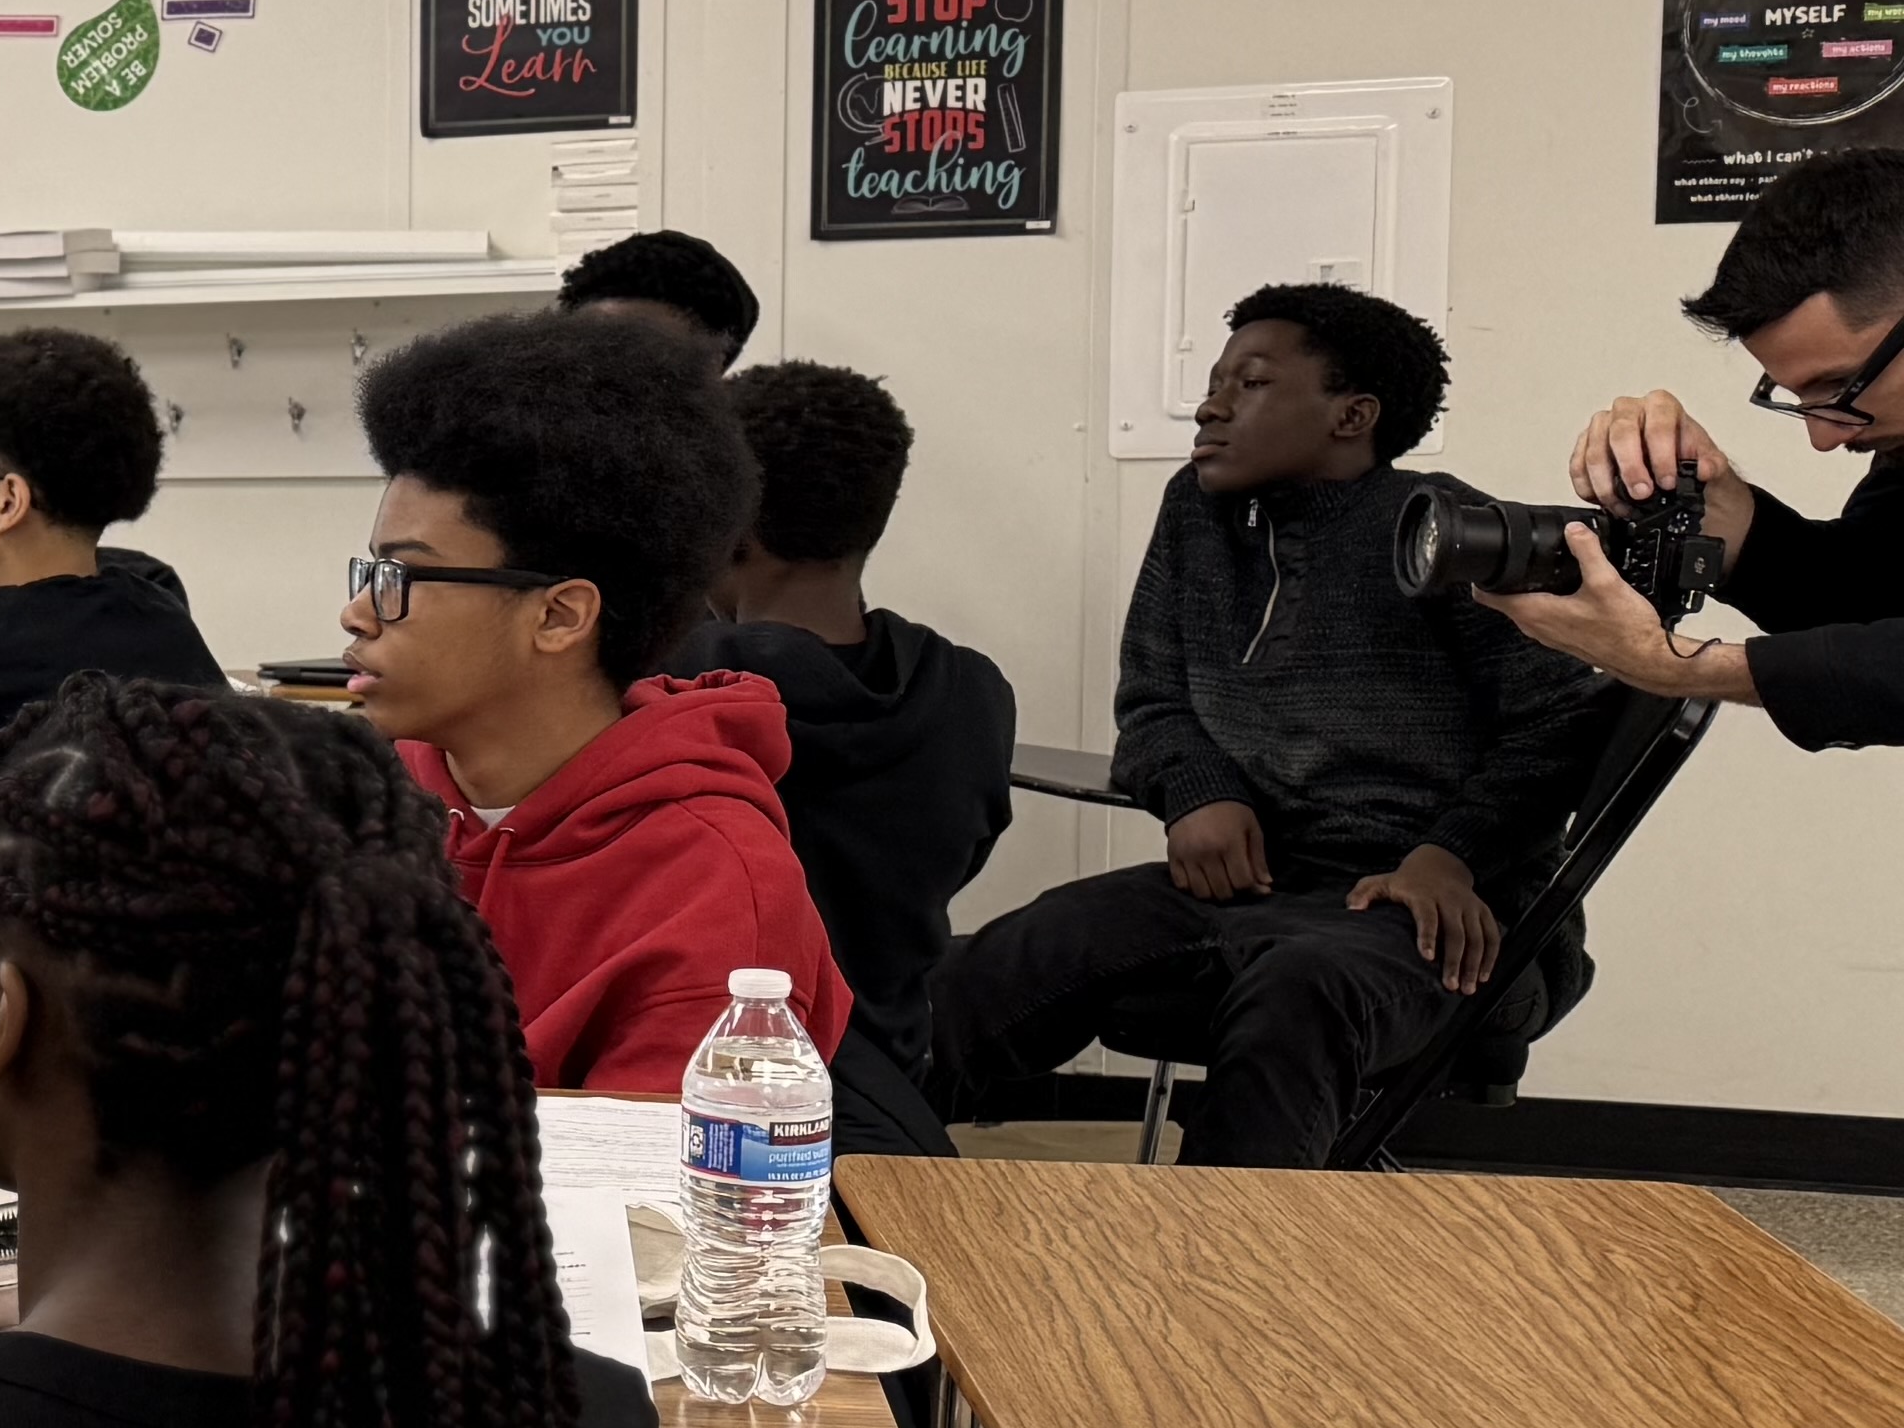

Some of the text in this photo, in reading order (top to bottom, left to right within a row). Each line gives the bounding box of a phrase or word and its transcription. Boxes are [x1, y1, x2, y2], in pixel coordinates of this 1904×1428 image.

[61, 11, 123, 69] SOLVER
[535, 26, 591, 47] YOU
[844, 0, 1032, 78] learning
[1764, 4, 1846, 26] MYSELF
[71, 23, 149, 95] PROBLEM
[459, 14, 598, 97] Learn
[884, 59, 988, 80] BECAUSE LIFE
[883, 76, 987, 117] NEVER
[884, 109, 986, 154] STOPS
[842, 130, 1027, 210] teaching
